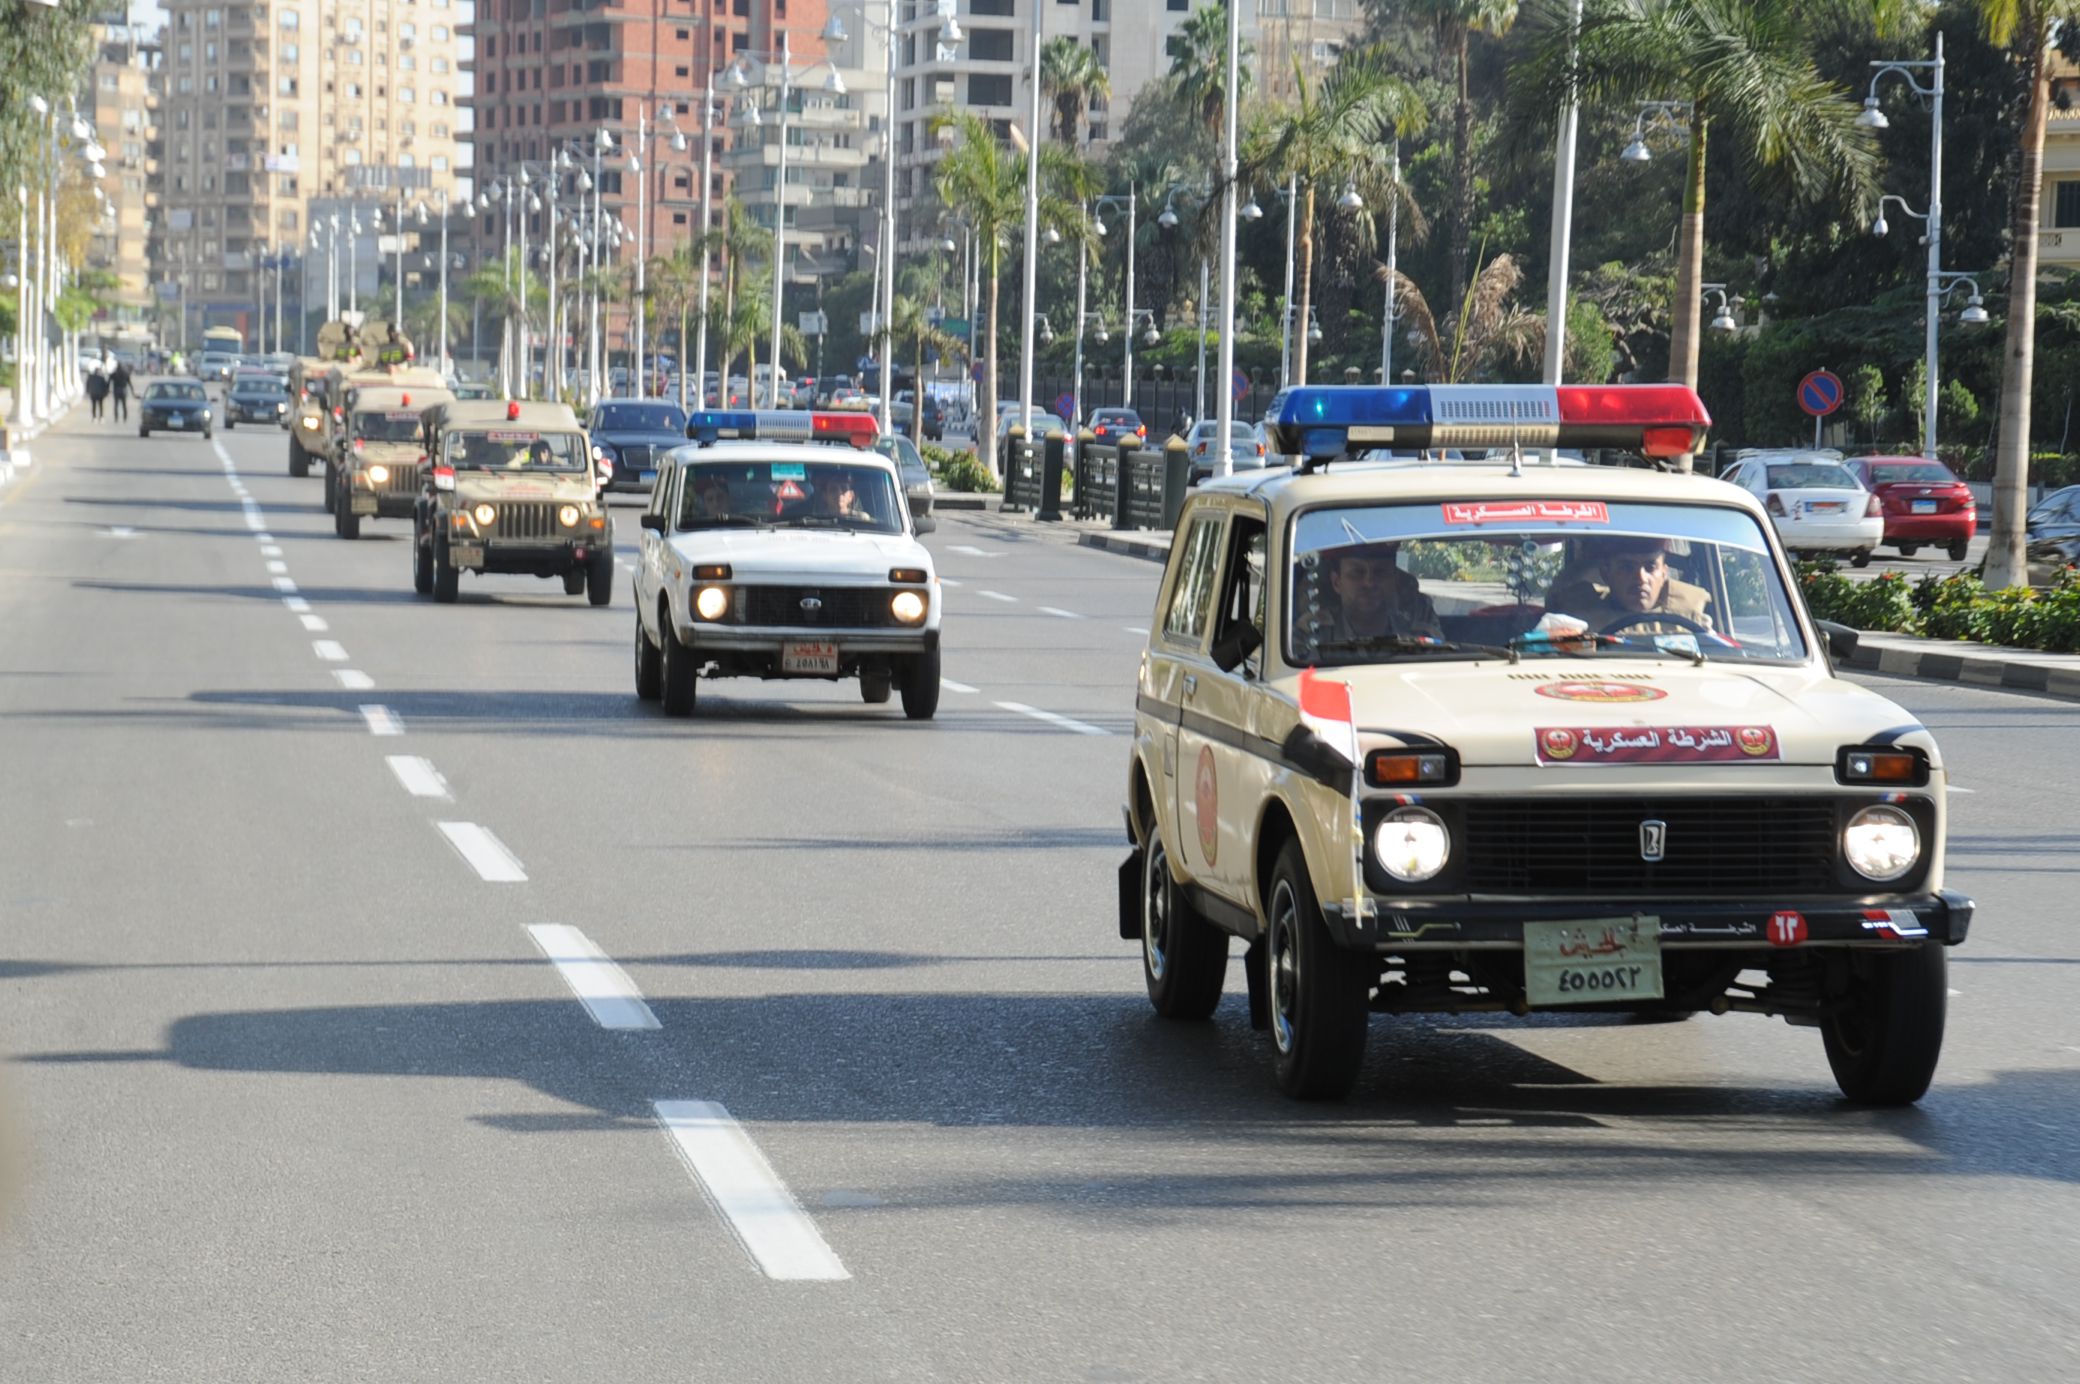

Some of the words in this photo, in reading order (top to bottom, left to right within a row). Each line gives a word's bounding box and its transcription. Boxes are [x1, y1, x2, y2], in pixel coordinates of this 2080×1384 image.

[1452, 504, 1536, 521] العسكرية
[1539, 503, 1597, 519] الشرطة
[1583, 729, 1660, 752] العسكرية
[1667, 728, 1732, 751] الشرطة
